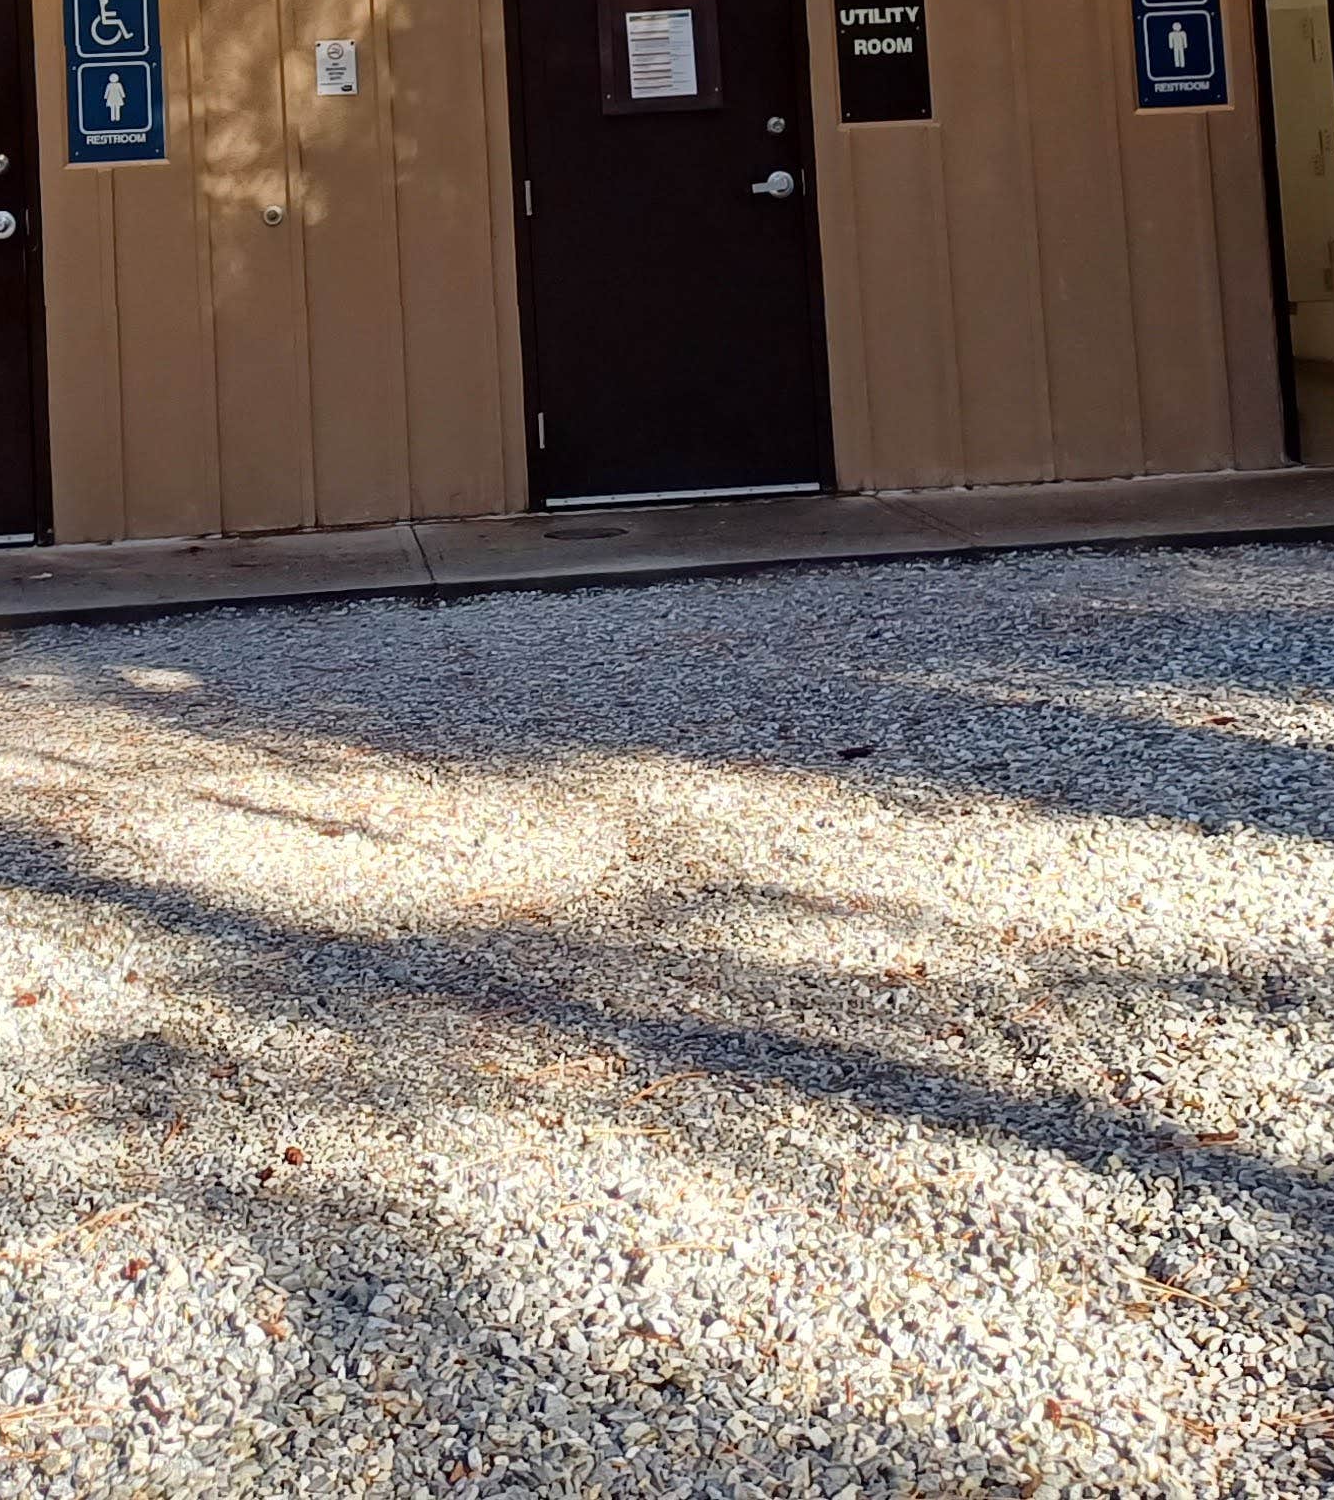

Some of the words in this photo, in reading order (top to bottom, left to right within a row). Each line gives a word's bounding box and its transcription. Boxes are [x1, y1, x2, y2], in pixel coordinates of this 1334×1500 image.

[840, 6, 920, 26] UTILITY
[854, 37, 913, 55] ROOM
[1154, 81, 1210, 93] RESTROOM
[86, 133, 147, 145] RESTROOM
